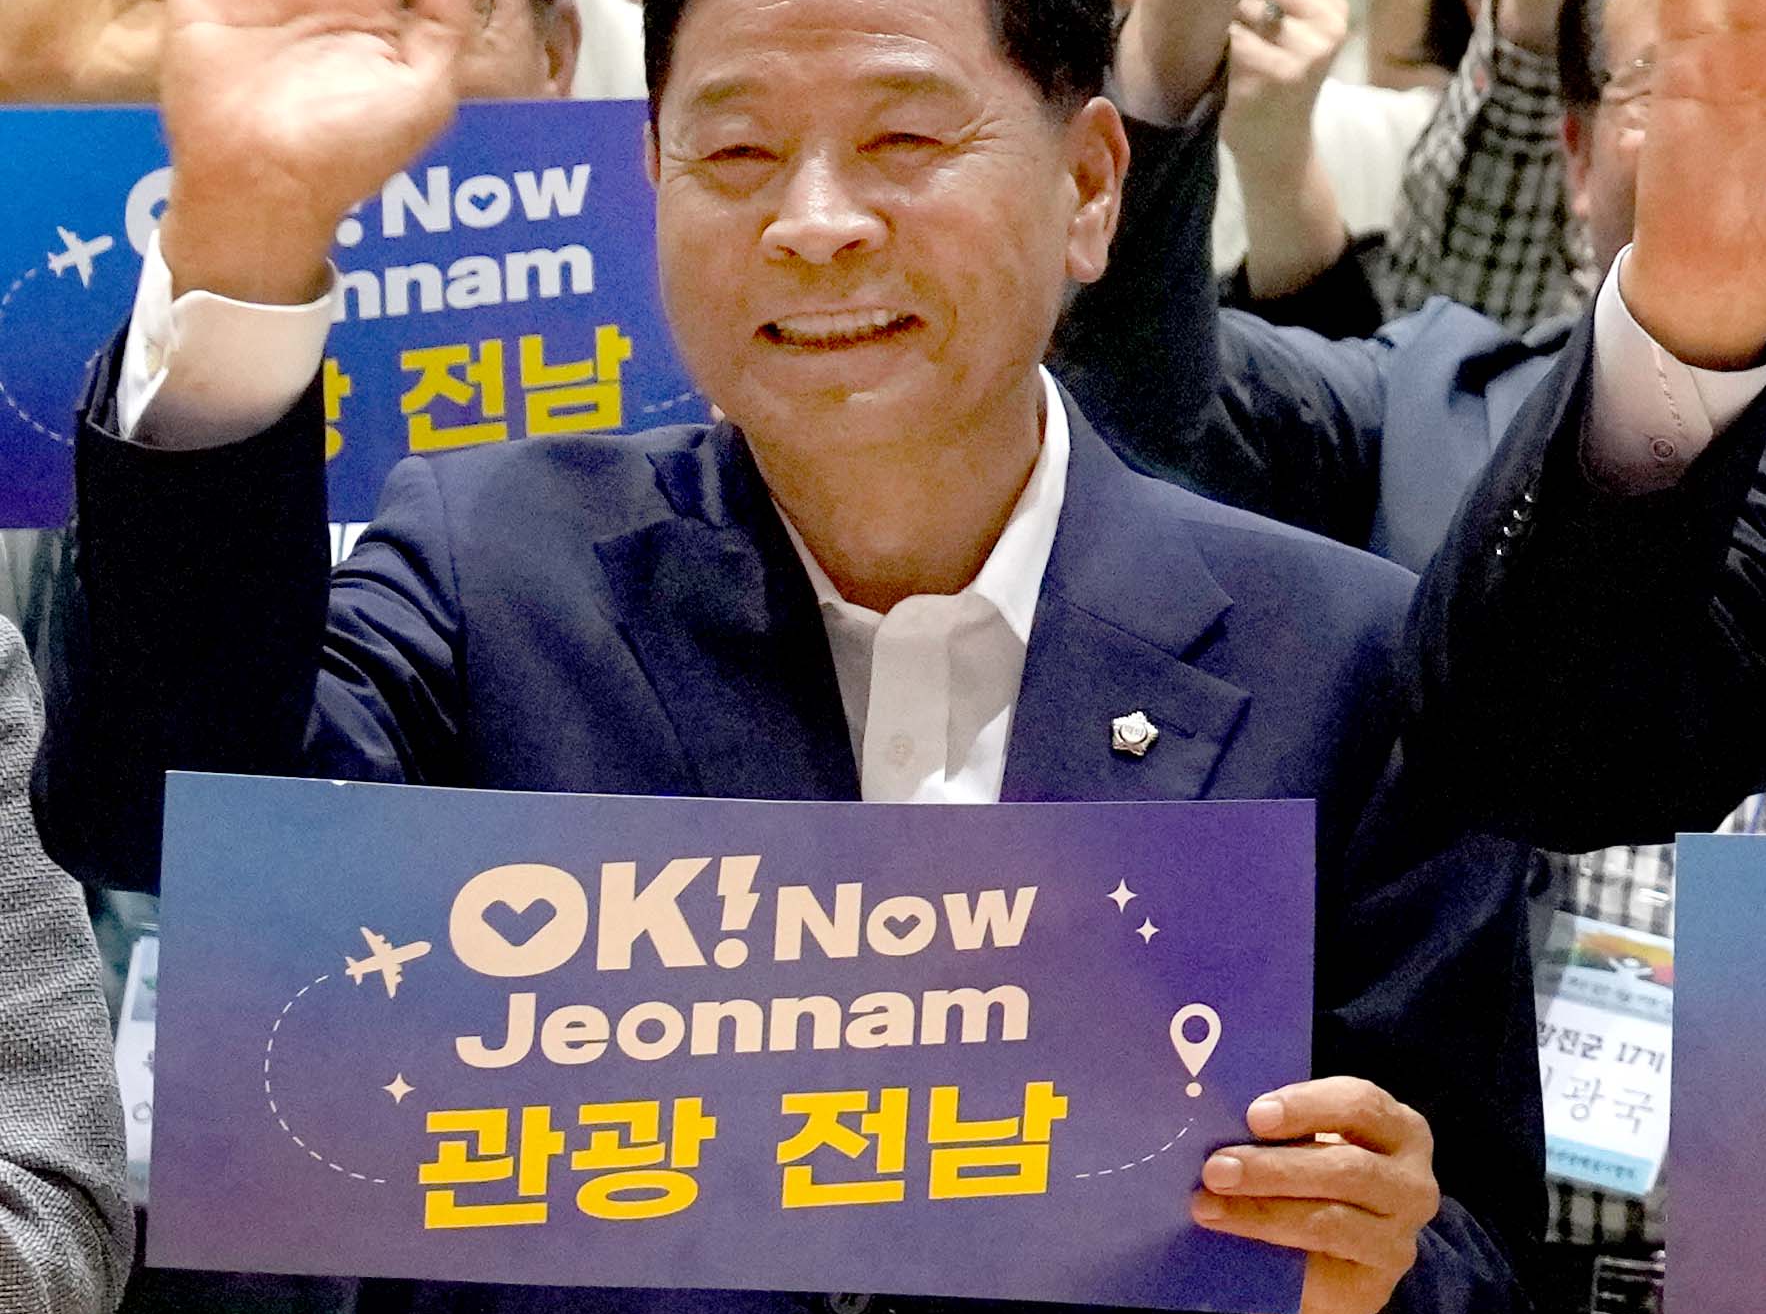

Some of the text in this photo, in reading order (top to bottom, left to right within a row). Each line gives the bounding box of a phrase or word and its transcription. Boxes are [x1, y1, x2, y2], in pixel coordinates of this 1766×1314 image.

[381, 164, 593, 240] Now
[330, 243, 596, 325] nnam
[400, 324, 634, 455] 전남
[448, 855, 1039, 979] OK! Now
[455, 983, 1031, 1070] Jeonnam
[416, 1079, 1071, 1231] 관광 전남
